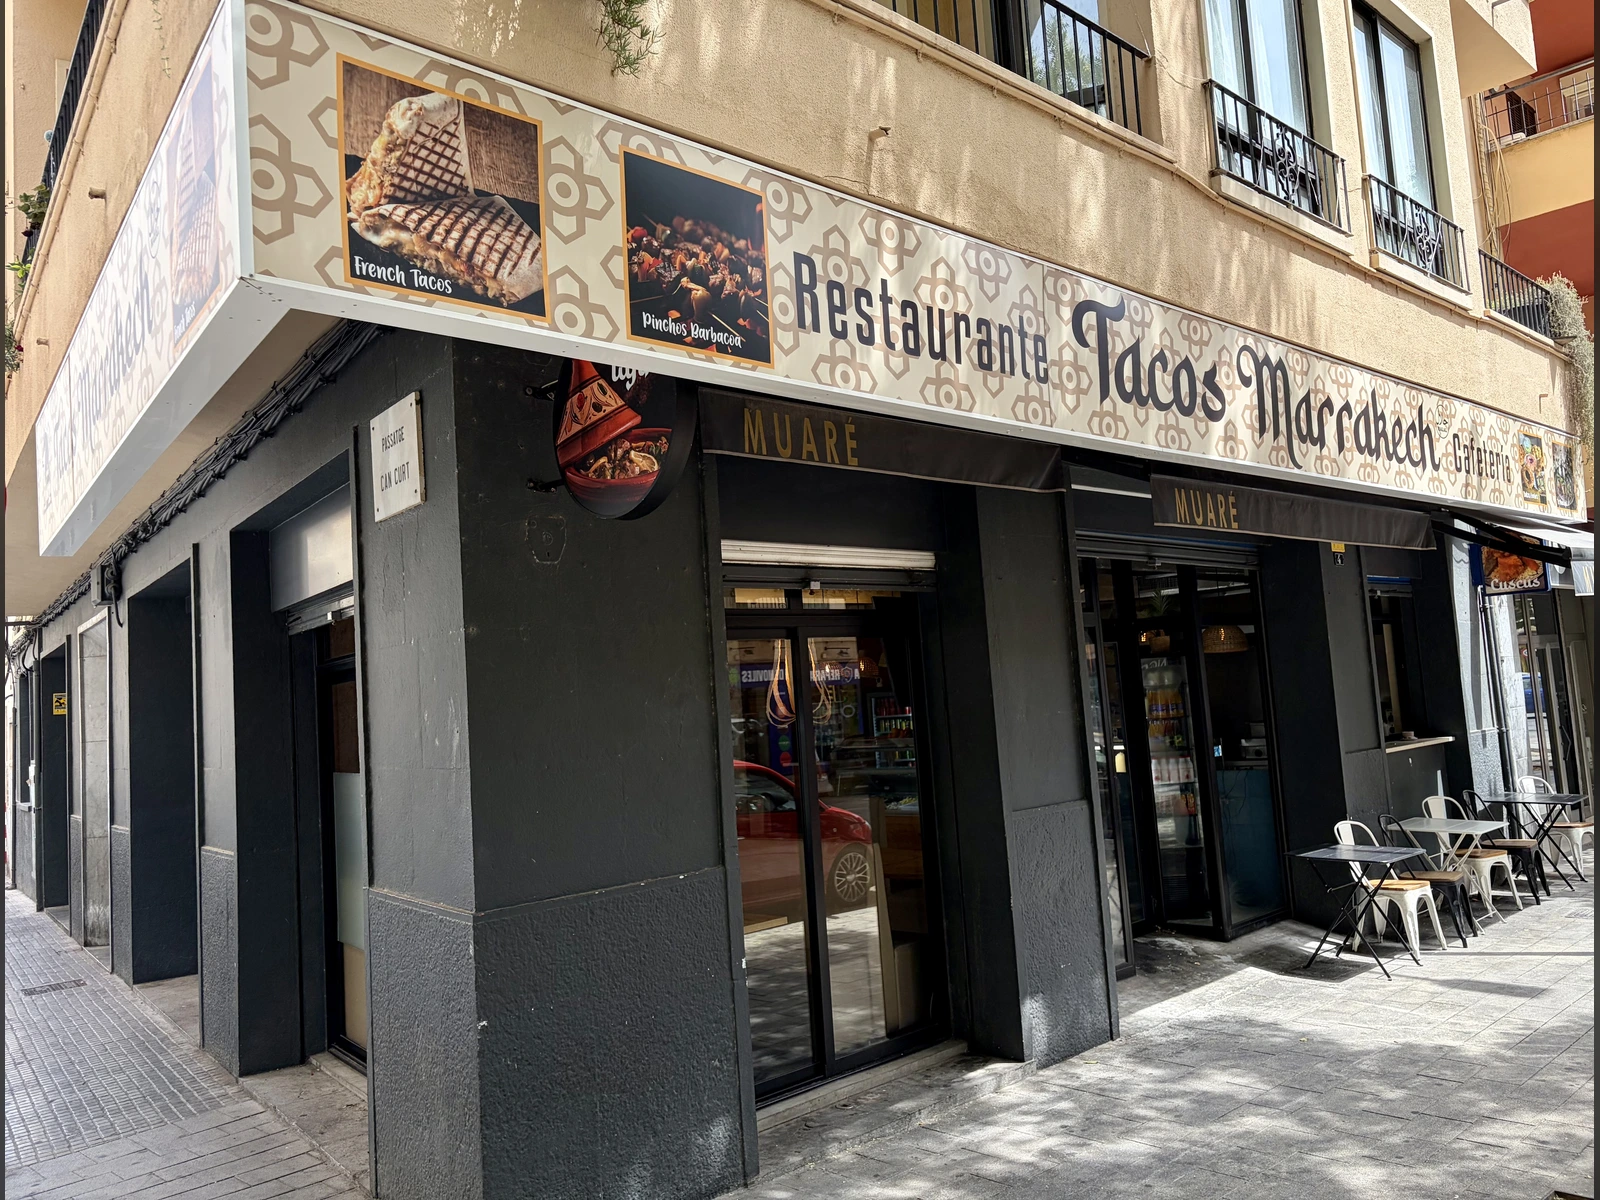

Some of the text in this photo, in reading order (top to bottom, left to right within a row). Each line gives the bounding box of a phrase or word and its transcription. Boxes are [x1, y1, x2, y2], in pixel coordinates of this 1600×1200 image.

[353, 255, 453, 294] French Tacos
[642, 311, 742, 348] Pinchos Barbacoa
[793, 250, 1511, 483] Restaurante Tacos Marrakech Cafetería
[381, 426, 405, 453] PASSATGE
[743, 407, 859, 466] MUARÉ
[380, 461, 410, 491] CAN CURT
[1174, 487, 1239, 529] MUARÉ
[1490, 577, 1541, 591] Cuscus
